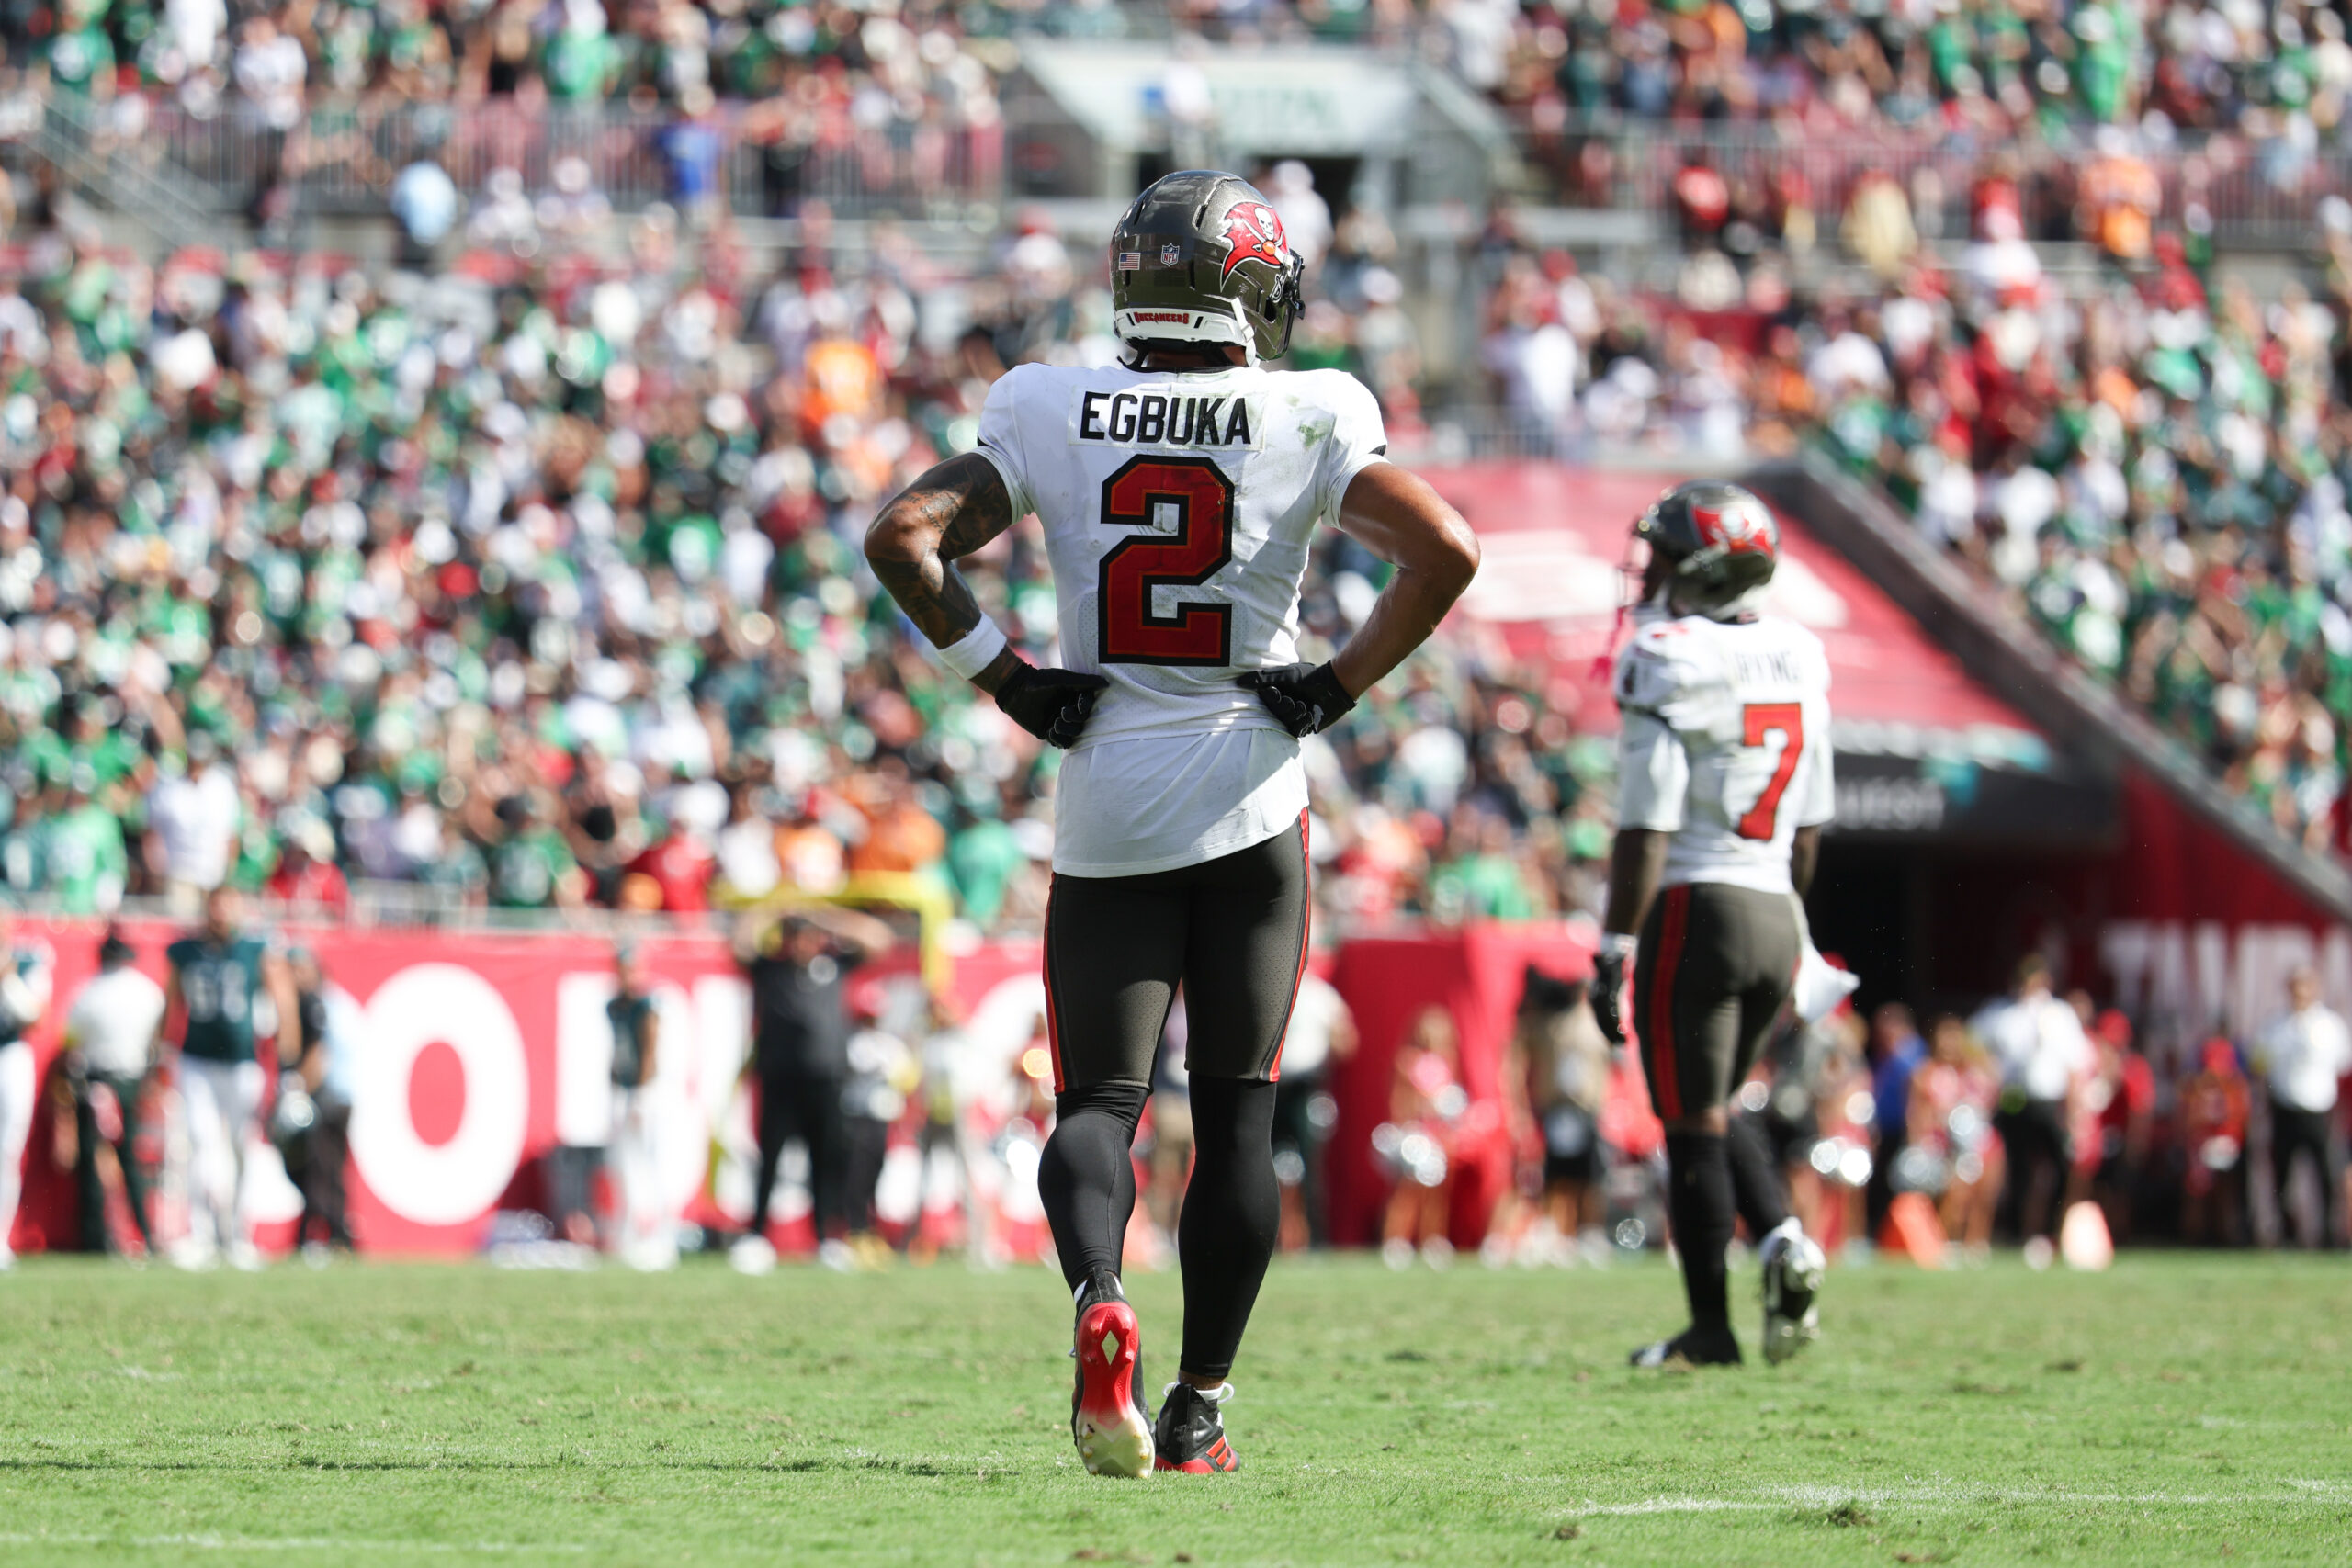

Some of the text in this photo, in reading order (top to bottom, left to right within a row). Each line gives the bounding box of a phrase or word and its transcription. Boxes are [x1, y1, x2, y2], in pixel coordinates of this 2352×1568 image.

[1163, 253, 1177, 264] NFL
[1133, 311, 1190, 325] BUCCANEERS
[1080, 391, 1251, 445] EGBUKA
[1098, 454, 1235, 667] 2
[1737, 702, 1804, 840] 7
